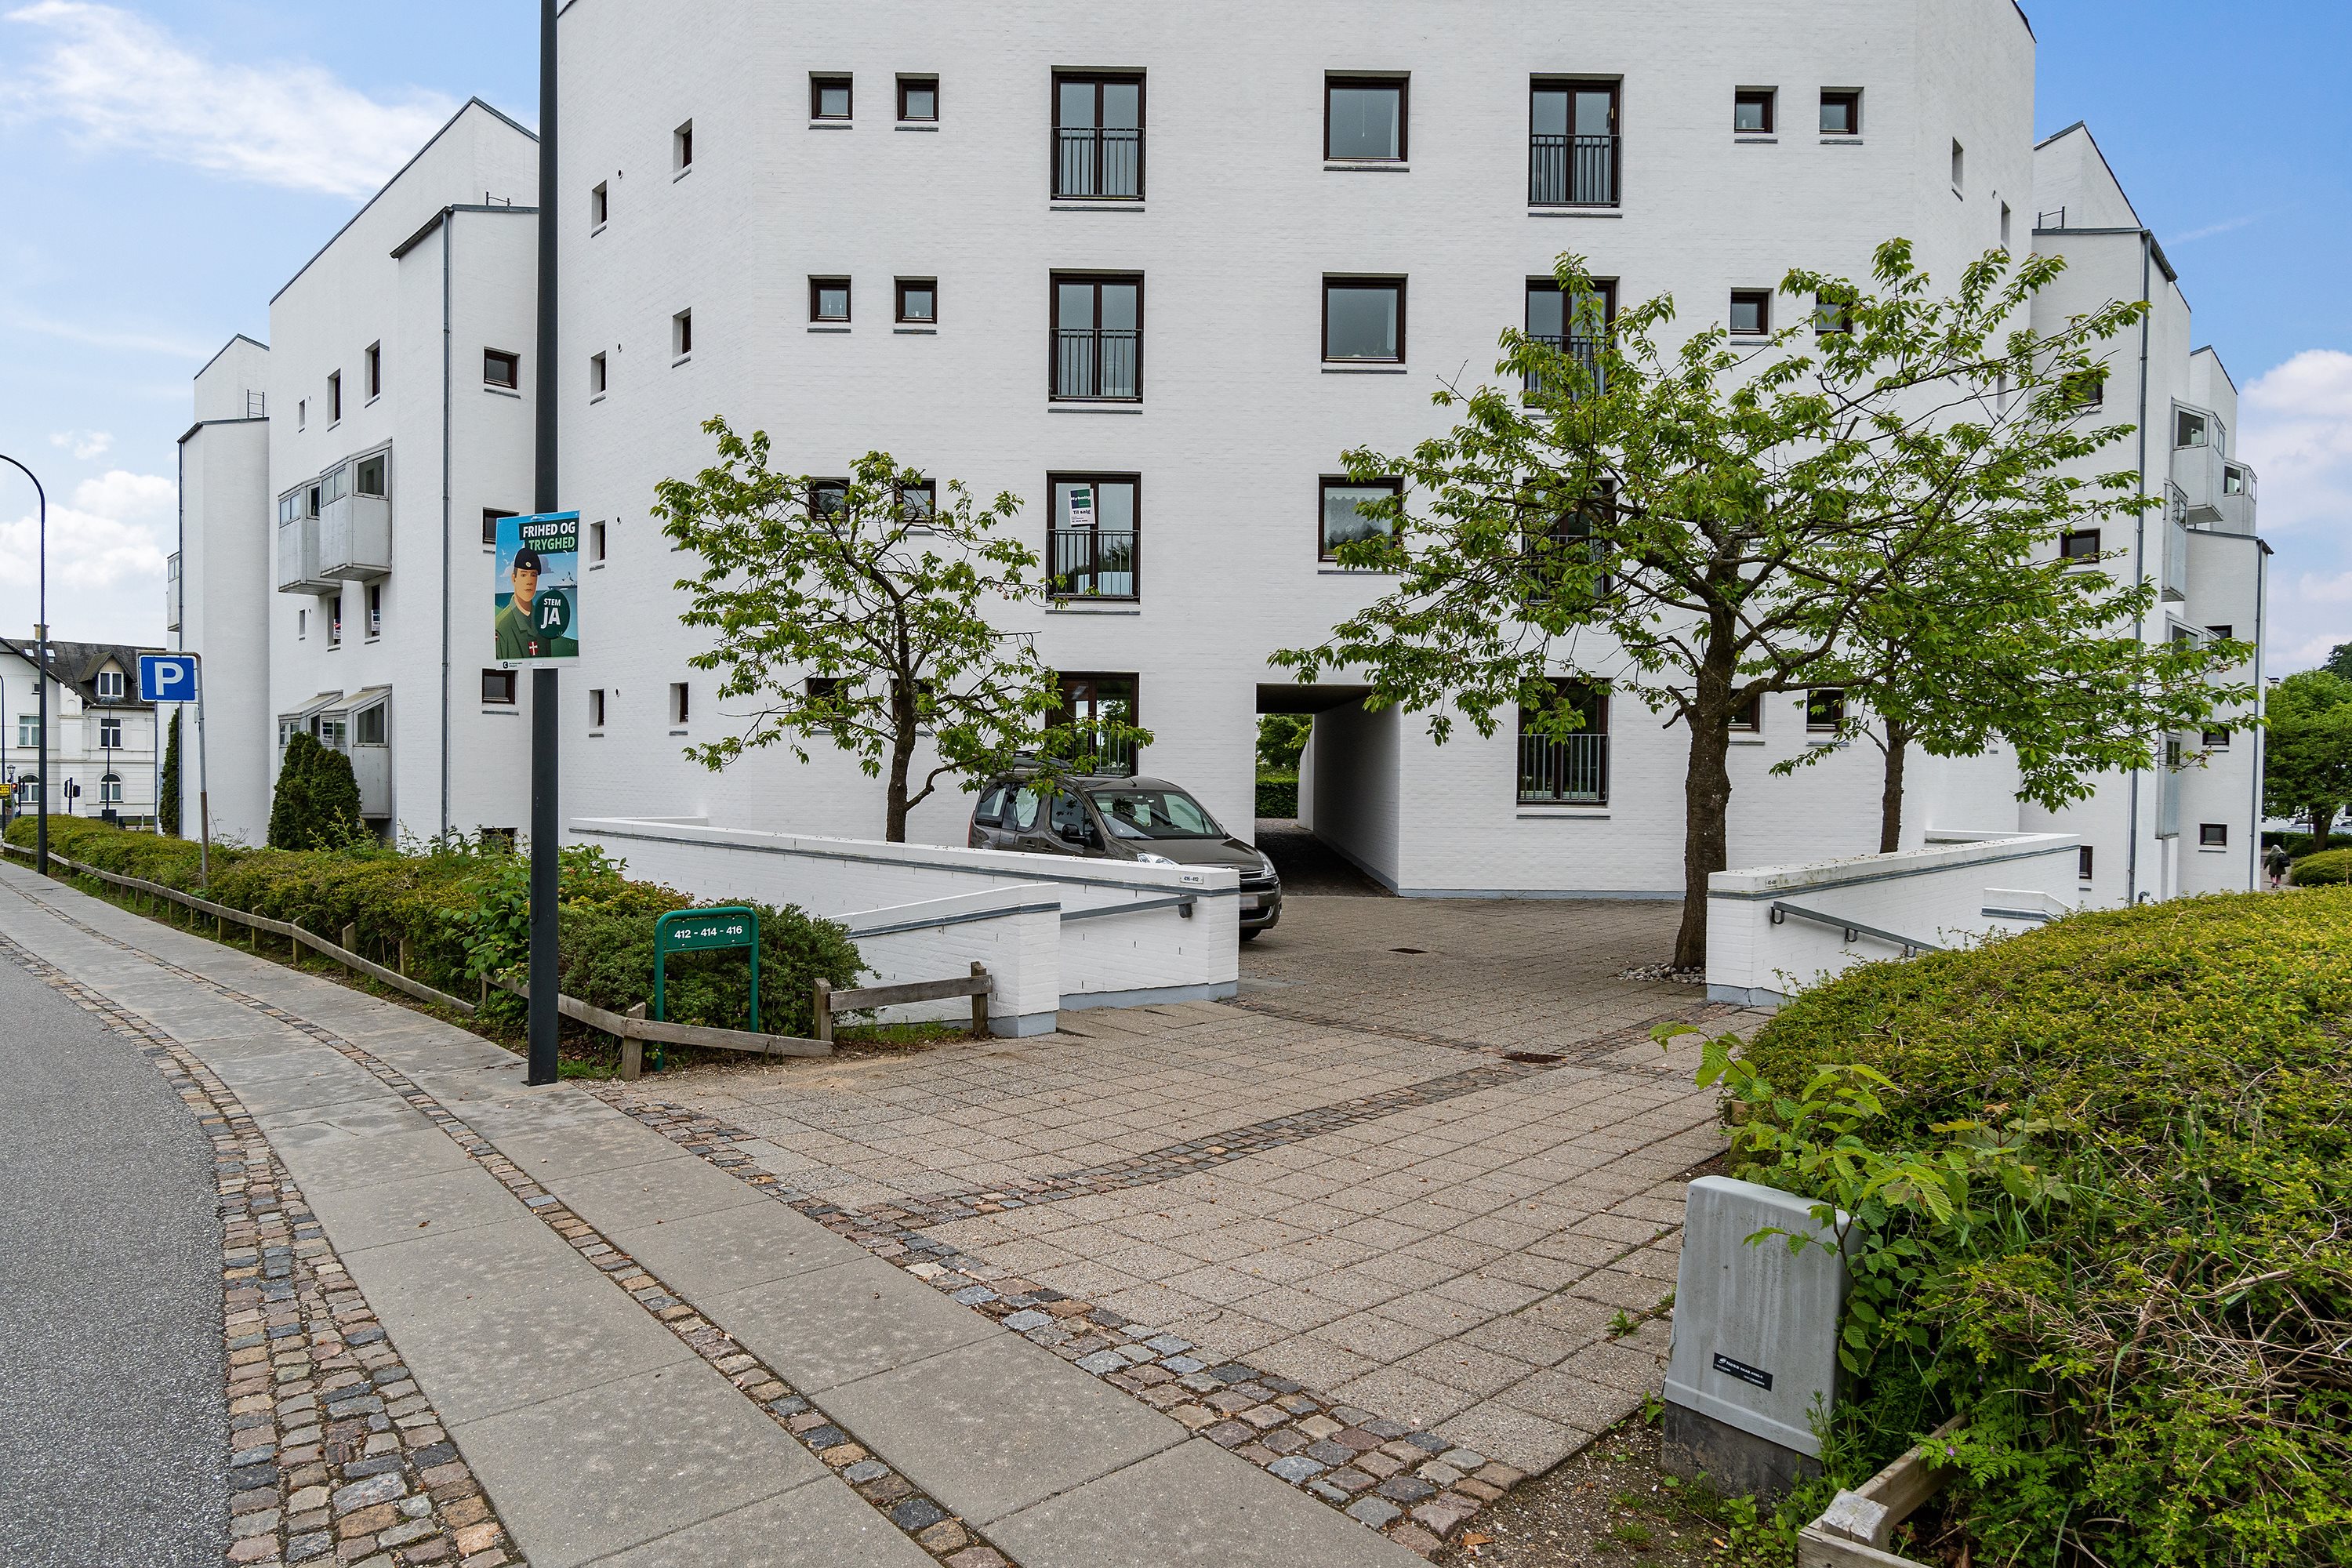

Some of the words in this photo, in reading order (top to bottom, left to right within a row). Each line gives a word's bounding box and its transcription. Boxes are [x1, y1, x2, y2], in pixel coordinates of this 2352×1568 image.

[523, 523, 558, 538] FRIHED
[560, 521, 575, 535] OG
[528, 536, 575, 551] TRYGHED
[543, 597, 561, 607] STEM
[540, 607, 561, 629] JA
[154, 662, 184, 695] P
[674, 929, 691, 939] 412
[700, 927, 717, 937] 414
[726, 925, 742, 935] 416
